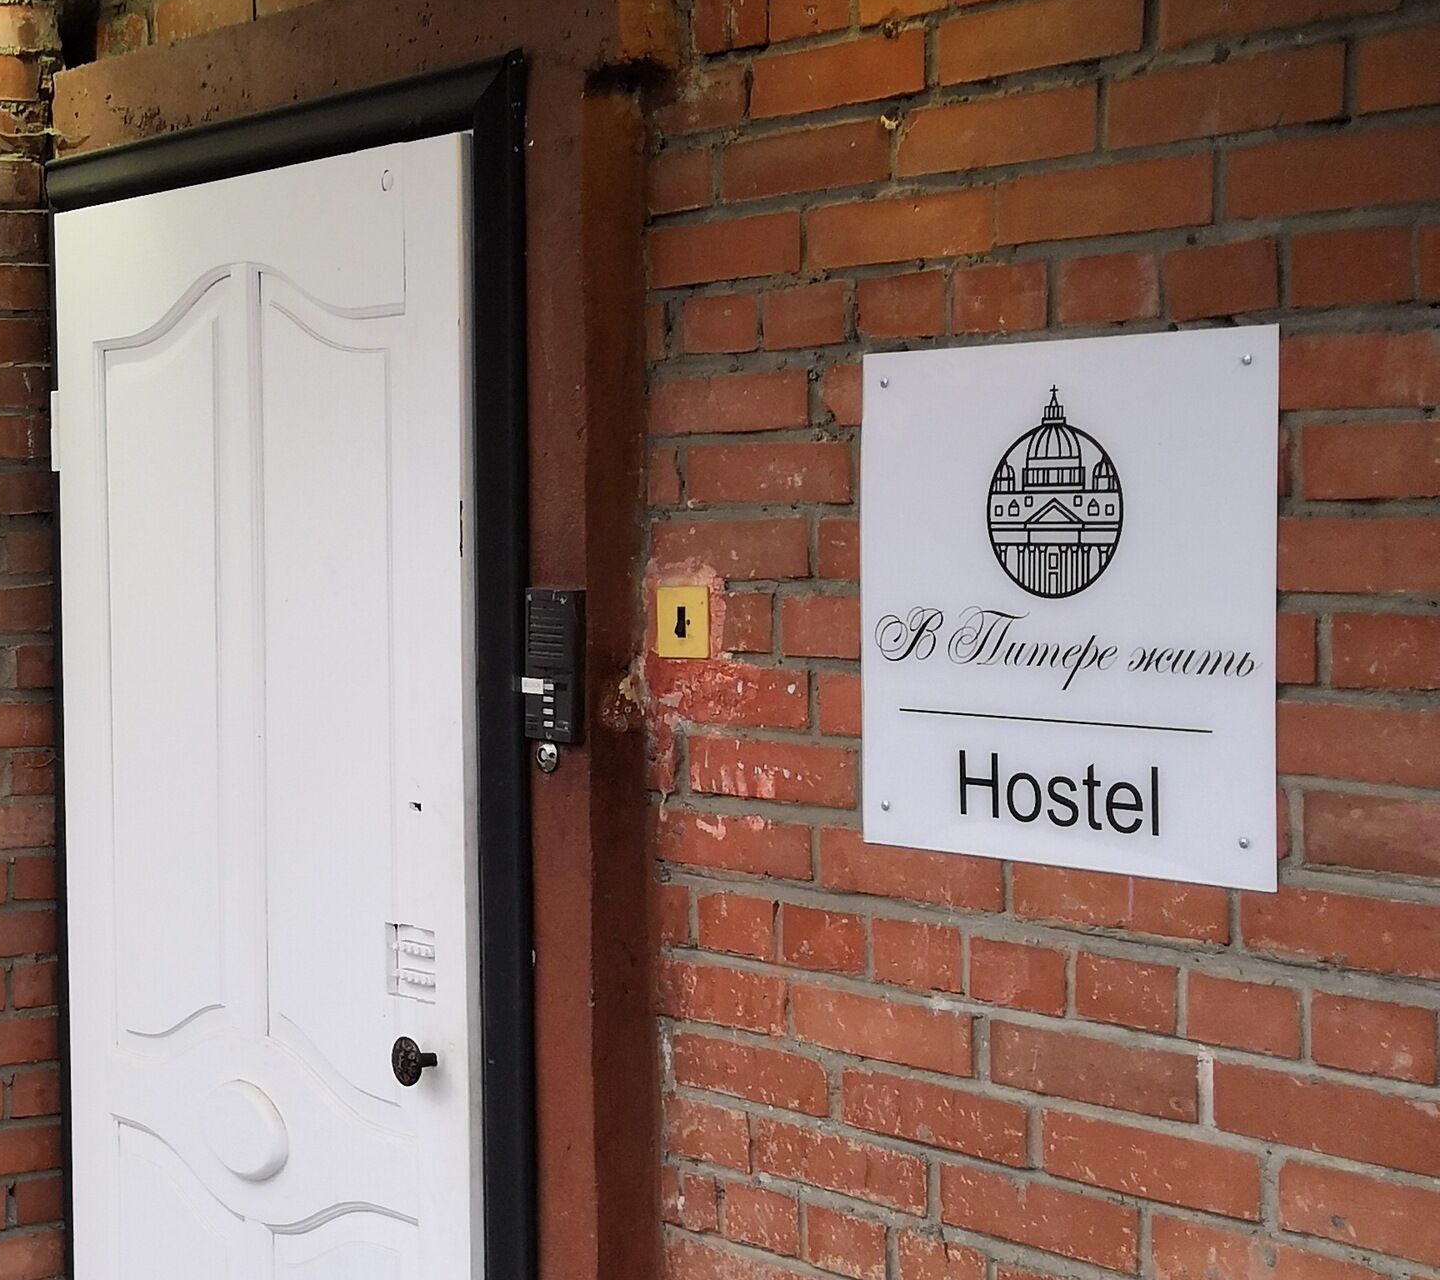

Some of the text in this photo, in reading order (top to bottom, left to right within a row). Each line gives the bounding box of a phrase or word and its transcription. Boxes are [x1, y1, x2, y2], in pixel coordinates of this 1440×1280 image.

[874, 605, 1261, 691] В Питере жить
[958, 749, 1161, 837] Hostel
